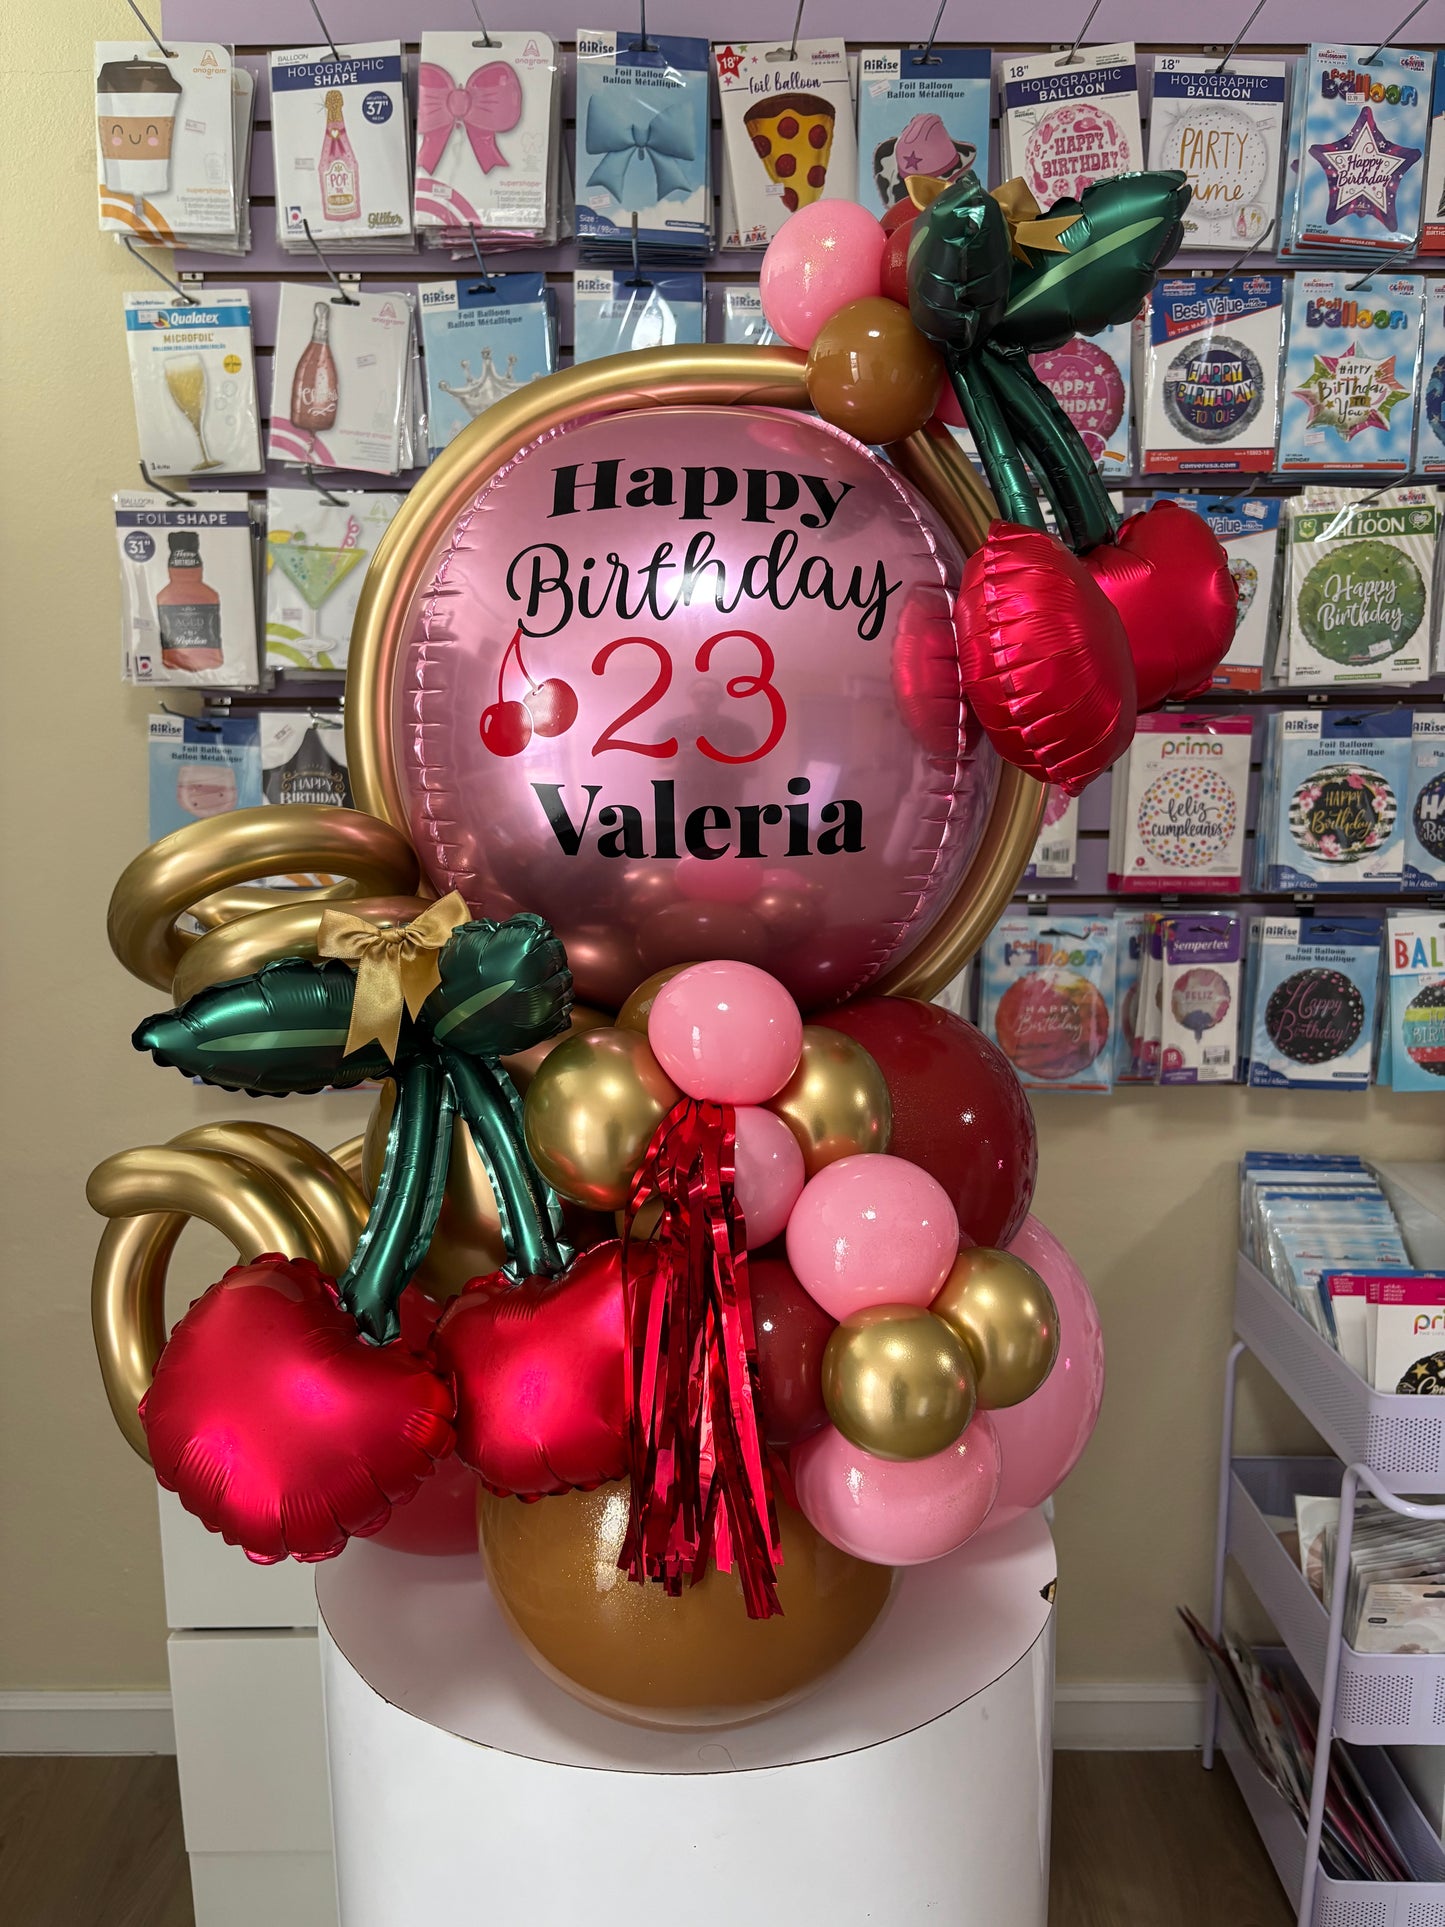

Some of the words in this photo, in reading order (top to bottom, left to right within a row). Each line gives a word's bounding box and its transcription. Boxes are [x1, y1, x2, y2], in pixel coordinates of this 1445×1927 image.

[579, 40, 614, 53] AiRise
[287, 59, 385, 78] HOLOGRAPHIC
[720, 56, 739, 69] 18"
[864, 60, 898, 70] AiRise
[1161, 59, 1181, 71] 18"
[314, 72, 358, 86] SHAPE
[615, 68, 631, 76] Foil
[1010, 65, 1029, 78] 18"
[602, 76, 631, 85] Ballon
[774, 71, 821, 90] balloon
[899, 81, 916, 90] Foil
[919, 81, 953, 90] Balloon
[1021, 69, 1121, 93] HOLOGRAPHIC
[1171, 74, 1269, 89] HOLOGRAPHIC
[1322, 70, 1418, 107] balloon
[887, 90, 916, 98] Ballon
[919, 89, 965, 99] Métallique
[1039, 82, 1105, 101] BALLOON
[1187, 87, 1251, 99] BALLOON
[366, 100, 389, 117] 37"
[1054, 132, 1105, 156] HAPPY
[1179, 128, 1249, 170] PARTY
[1042, 151, 1119, 179] BIRTHDAY
[1346, 154, 1384, 177] Happy
[330, 173, 348, 188] POP
[1338, 167, 1391, 188] Birthday
[577, 281, 611, 291] AiRise
[422, 291, 455, 304] AiRise
[1316, 297, 1342, 310] Foil
[458, 311, 475, 319] Foil
[477, 309, 510, 318] Balloon
[1173, 302, 1207, 321] Best
[1207, 296, 1243, 317] Value
[1306, 300, 1408, 329] balloon
[171, 312, 219, 326] Qualatex
[447, 321, 476, 329] Ballon
[1189, 362, 1242, 383] HAPPY
[1178, 380, 1254, 404] BIRTHDAY
[1318, 376, 1387, 405] Birthday
[1196, 410, 1207, 424] TO
[1211, 409, 1230, 424] YOU
[1335, 397, 1363, 424] You
[546, 458, 856, 529] Happy
[136, 513, 171, 525] FOIL
[176, 513, 228, 525] SHAPE
[1207, 516, 1242, 535] Value
[128, 539, 151, 554] 31"
[506, 529, 903, 641] Birthday
[1323, 574, 1398, 604] Happy
[1317, 595, 1403, 631] Birthday
[591, 630, 788, 764] 23
[150, 723, 182, 734] AiRise
[1284, 721, 1319, 731] AiRise
[1161, 736, 1224, 759] prima
[293, 776, 334, 791] HAPPY
[280, 791, 346, 806] BIRTHDAY
[1326, 790, 1363, 807] HAPPY
[1160, 796, 1220, 823] feliz
[530, 777, 866, 860] Valeria
[1311, 808, 1373, 838] Birthday
[1152, 818, 1223, 842] cumpleaños
[1265, 926, 1298, 936] AiRise
[1173, 939, 1230, 953] Sempertex
[1185, 991, 1214, 1000] FELIZ
[1286, 980, 1343, 1019] Happy
[1025, 1005, 1080, 1014] HAPPY
[1015, 1013, 1083, 1042] Birthday
